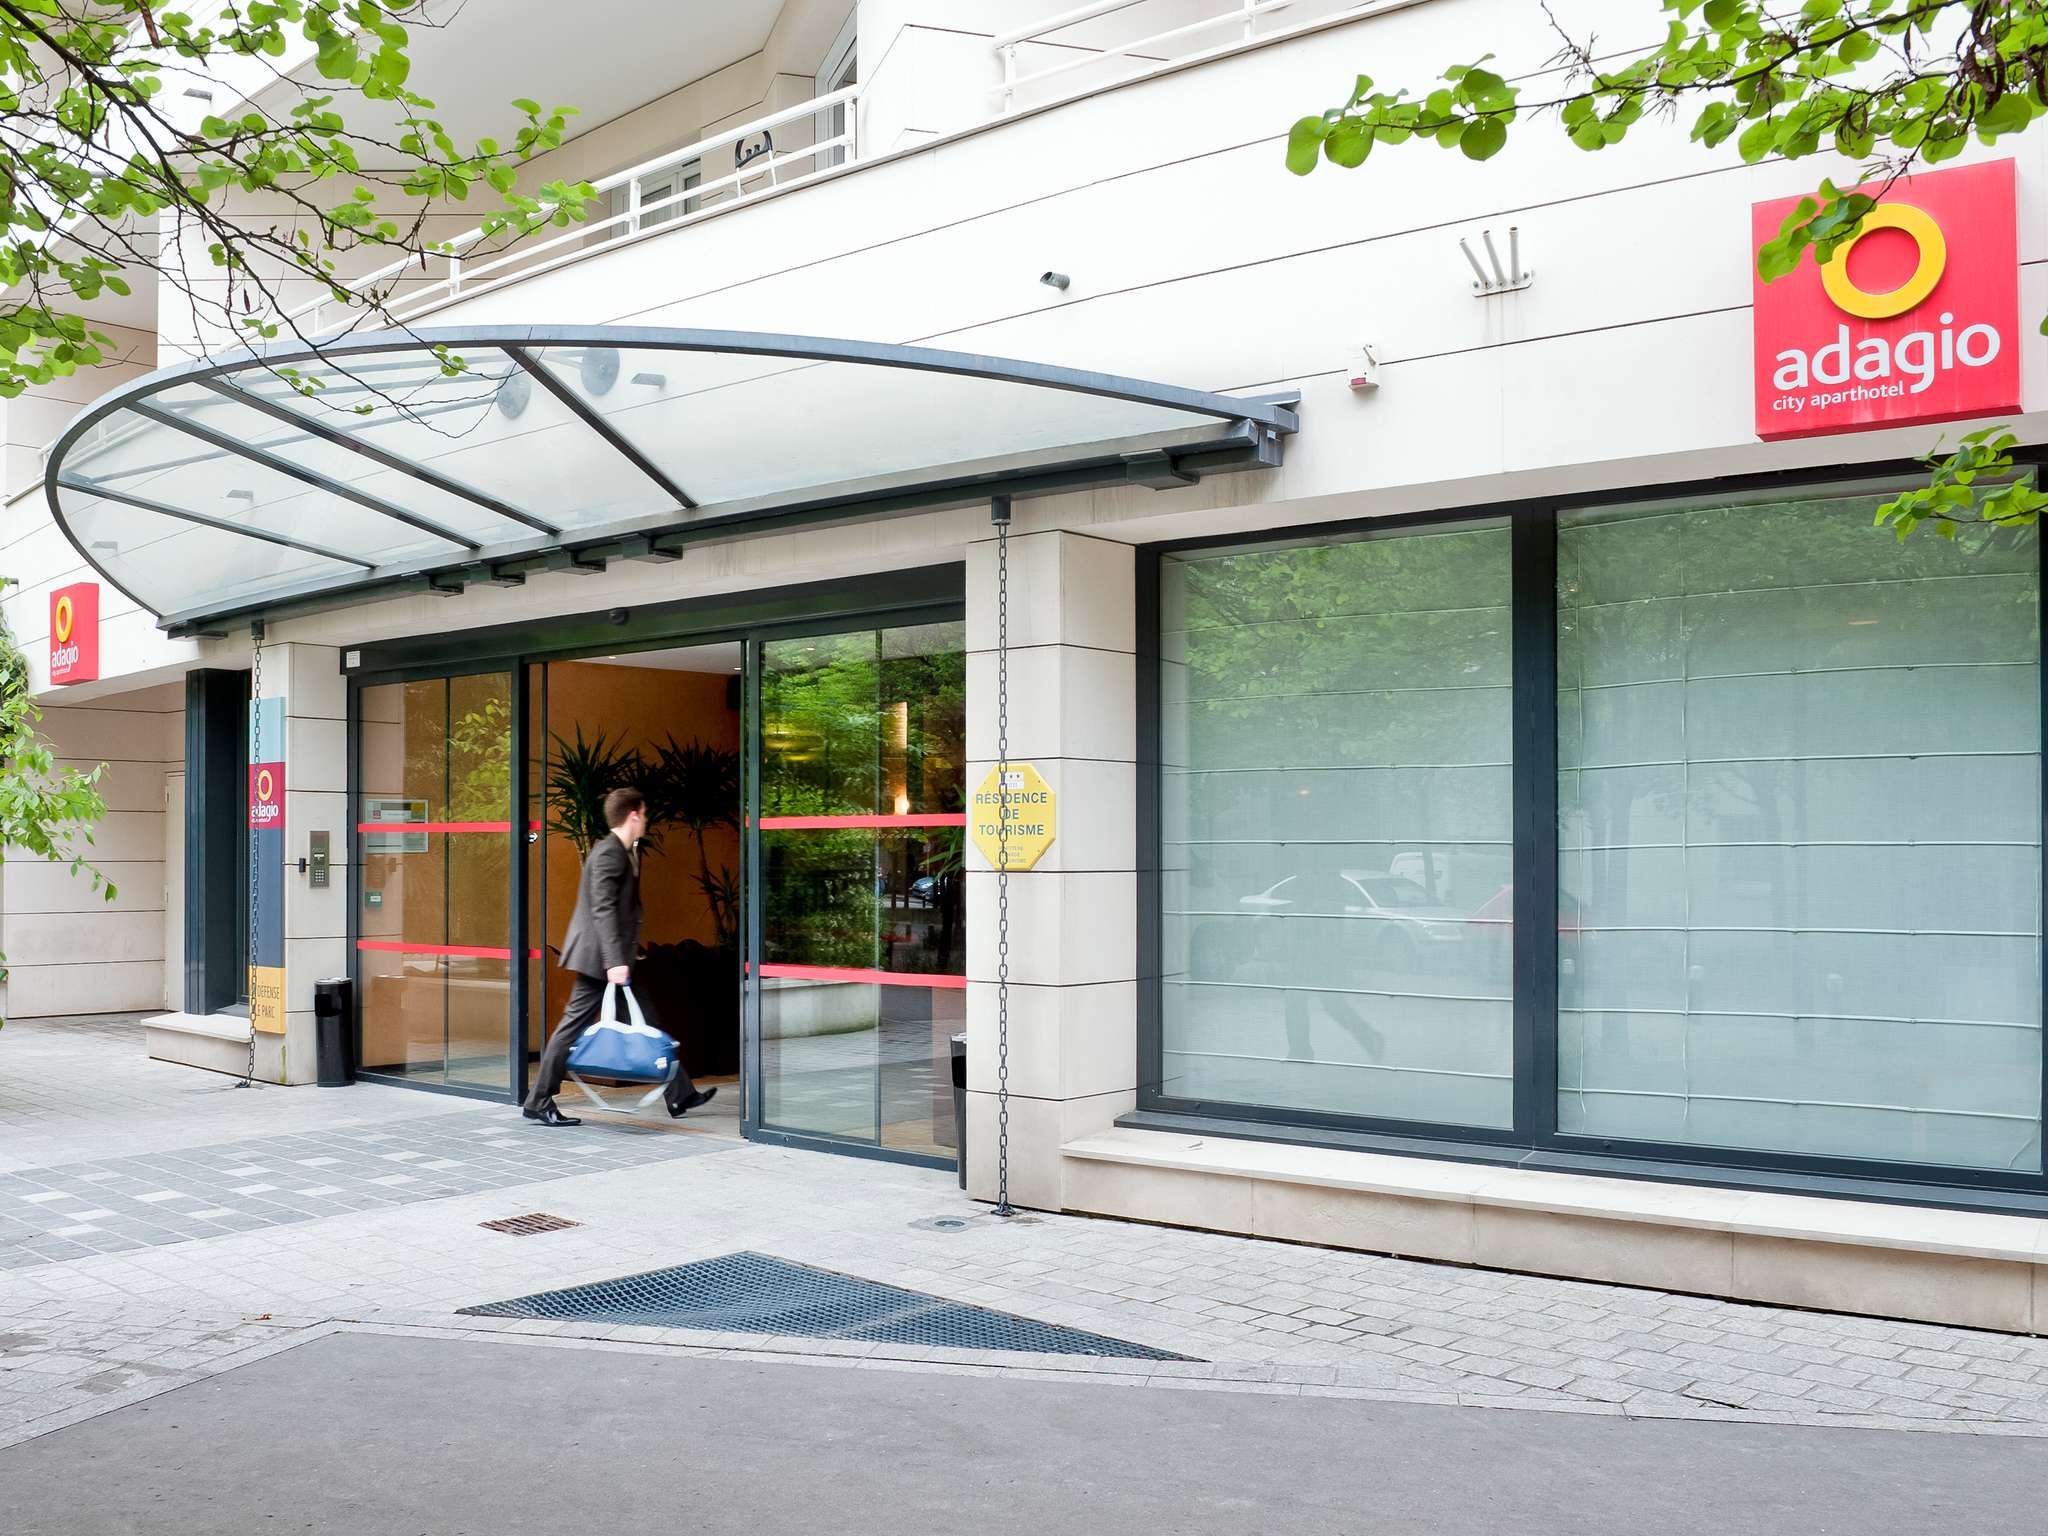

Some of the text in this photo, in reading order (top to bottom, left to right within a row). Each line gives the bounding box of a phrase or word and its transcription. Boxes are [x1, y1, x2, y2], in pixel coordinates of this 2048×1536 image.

[1773, 312, 2001, 394] adagio
[1772, 380, 1904, 413] city aparthotel
[51, 641, 79, 673] adagio
[975, 790, 1047, 804] RÉSDENCE
[251, 801, 279, 822] adagio
[1003, 808, 1019, 819] DE
[979, 824, 1044, 836] TOURISME
[262, 1004, 276, 1018] PARC
